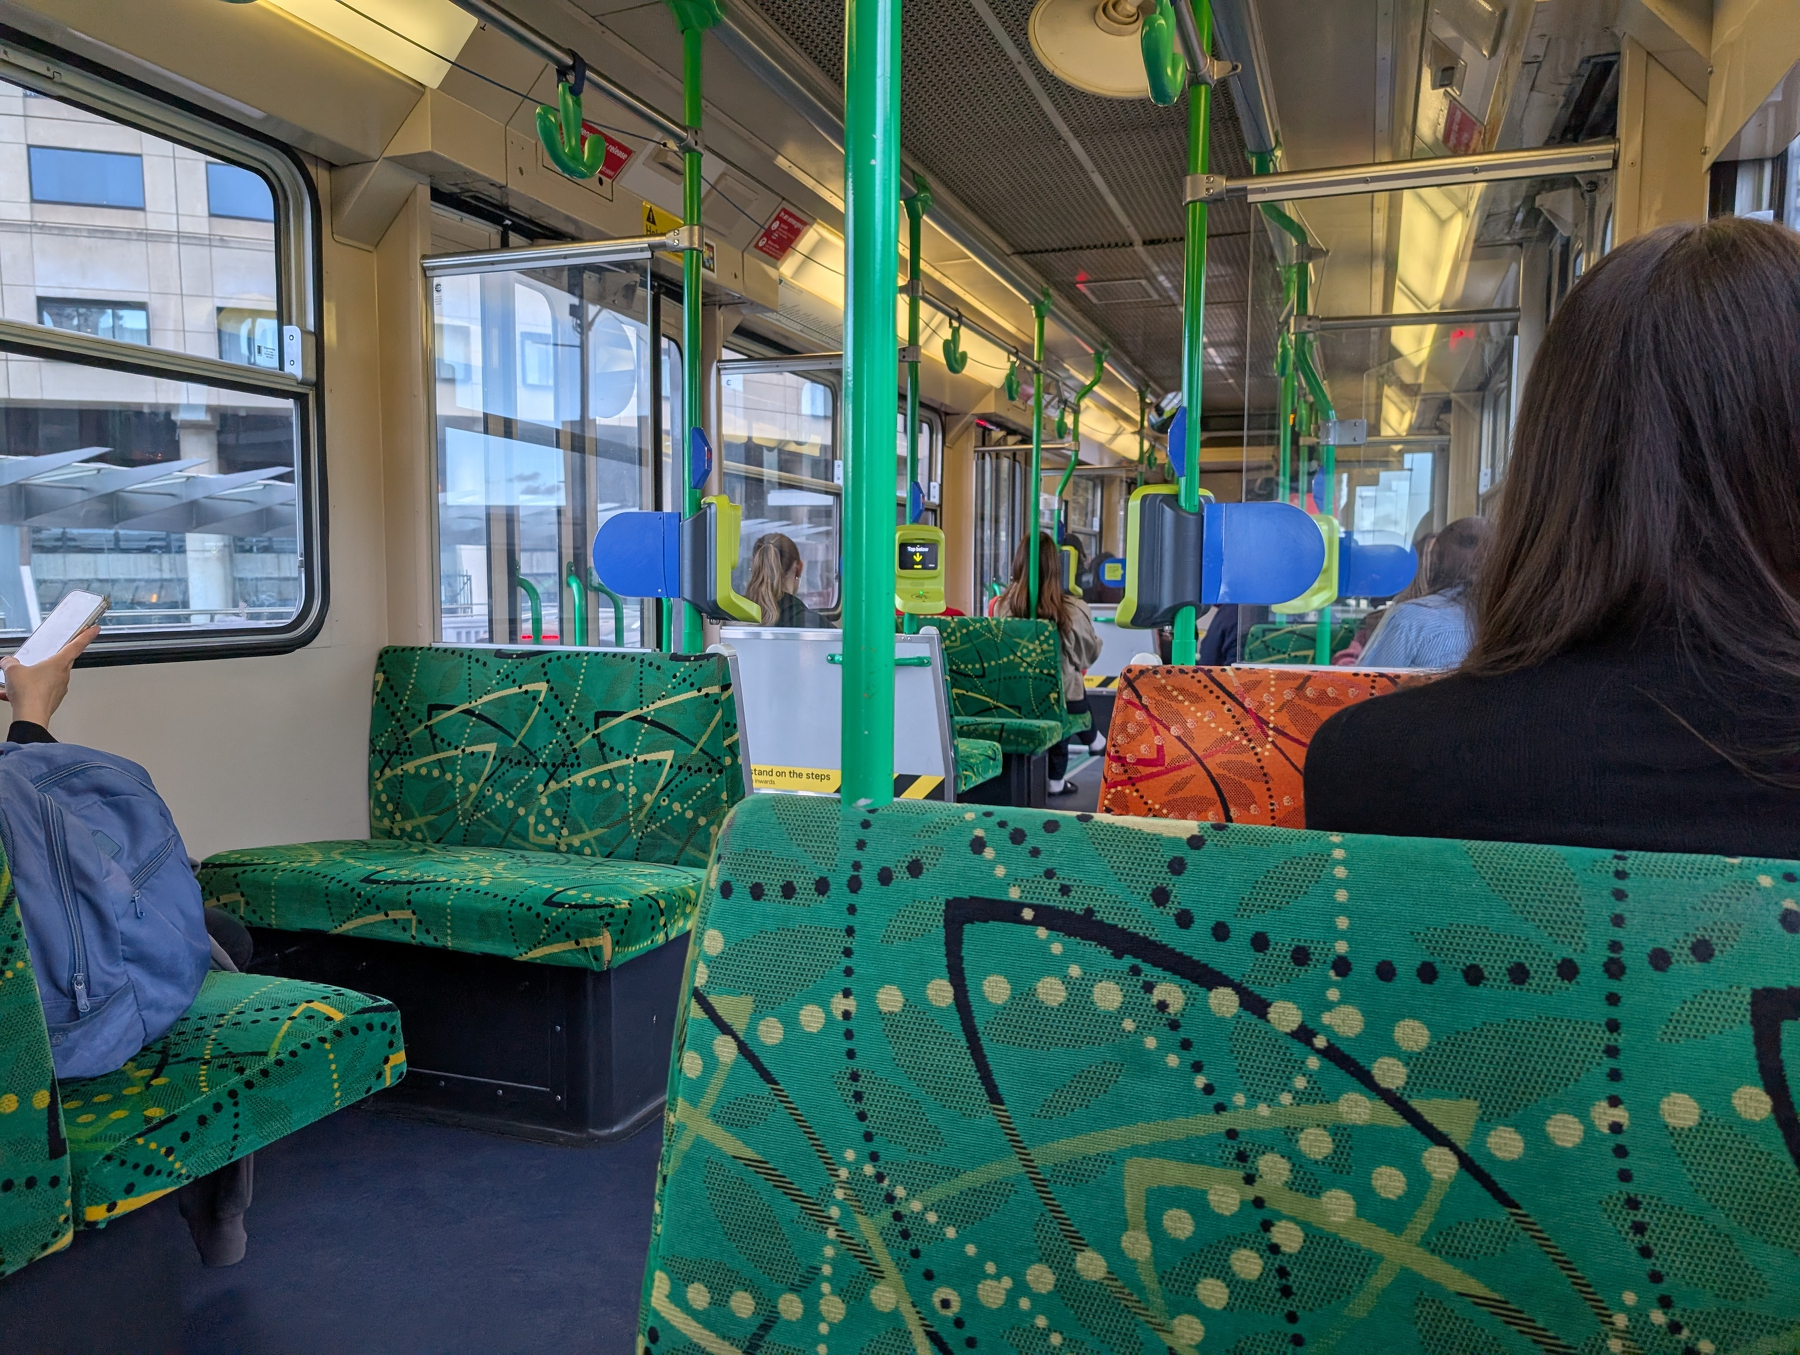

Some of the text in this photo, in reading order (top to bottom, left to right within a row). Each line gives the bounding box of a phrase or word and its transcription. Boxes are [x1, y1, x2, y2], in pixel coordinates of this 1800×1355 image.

[607, 145, 628, 160] release
[775, 770, 787, 778] on
[789, 770, 804, 779] the
[806, 771, 831, 783] steps
